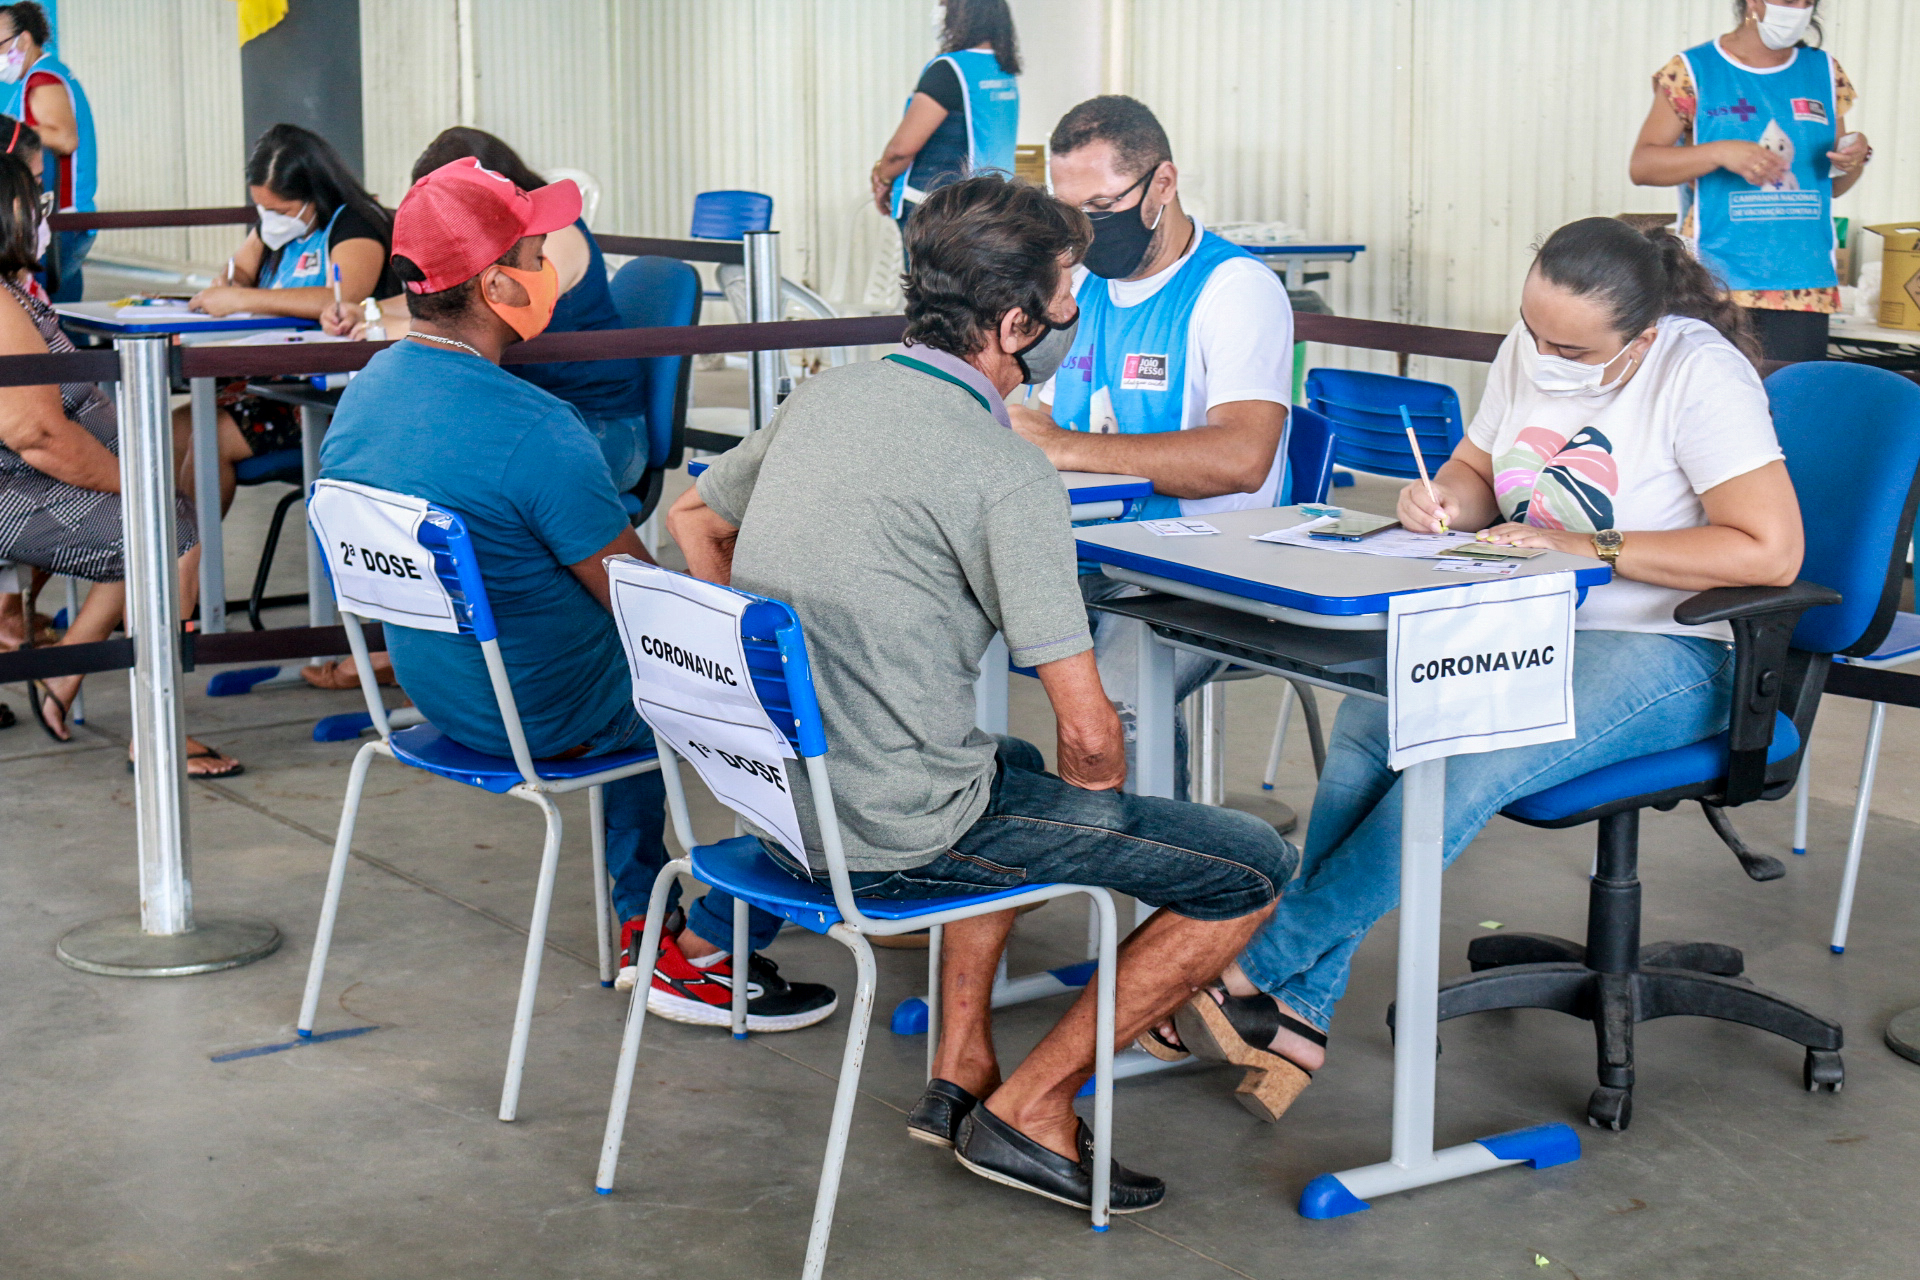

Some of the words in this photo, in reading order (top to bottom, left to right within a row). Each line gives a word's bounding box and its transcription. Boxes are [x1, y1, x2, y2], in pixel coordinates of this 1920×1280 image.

[1732, 194, 1779, 203] CAMPANHA
[1780, 193, 1819, 202] NACIONAL
[1061, 356, 1078, 369] US
[1137, 366, 1164, 376] PESSO
[340, 541, 356, 567] 2ª
[360, 547, 422, 580] DOSE
[641, 634, 738, 687] CORONAVAC
[1411, 645, 1555, 684] CORONAVAC
[688, 739, 712, 759] 1ª
[715, 747, 787, 794] DOSE
